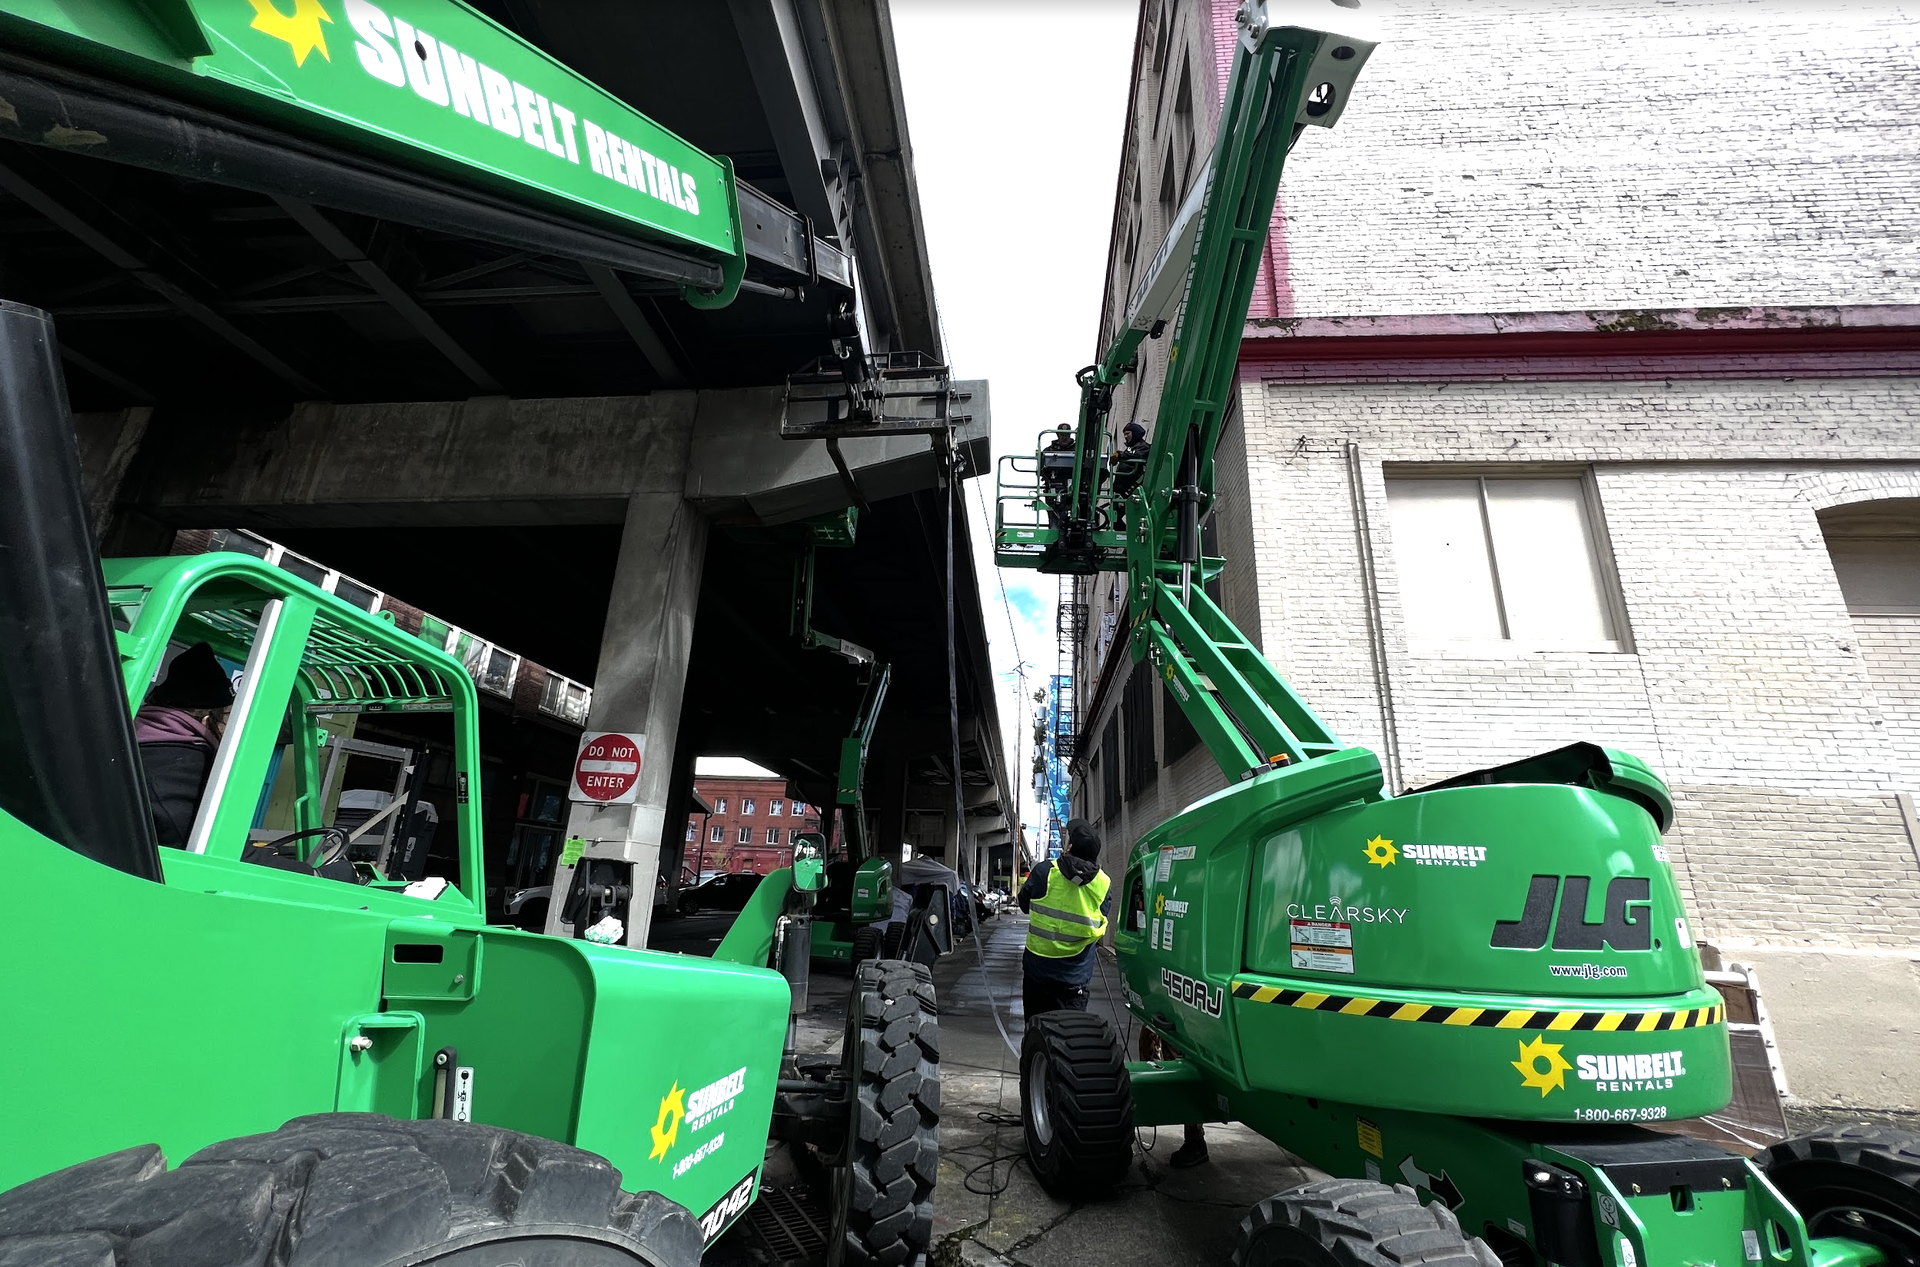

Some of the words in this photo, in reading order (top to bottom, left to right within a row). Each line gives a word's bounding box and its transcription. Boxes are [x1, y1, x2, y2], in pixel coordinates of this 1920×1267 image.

[343, 0, 579, 165] SUNBELT
[582, 118, 701, 217] RENTALS
[588, 745, 605, 757] DO
[611, 747, 635, 759] NOT
[586, 775, 625, 788] ENTER
[1402, 844, 1487, 861] SUNBELT
[1415, 859, 1477, 867] RENTALS
[1286, 903, 1407, 924] CLEARSKY
[1490, 874, 1653, 952] JLG
[1549, 964, 1627, 979] www.jlg.com
[1161, 967, 1224, 1019] 450AJ
[1596, 1078, 1674, 1092] RENTALS
[685, 1066, 747, 1124] SUNBELT
[691, 1098, 735, 1133] RENTALS
[1574, 1106, 1667, 1122] 1-800-667-9328
[700, 1176, 753, 1243] 7042
